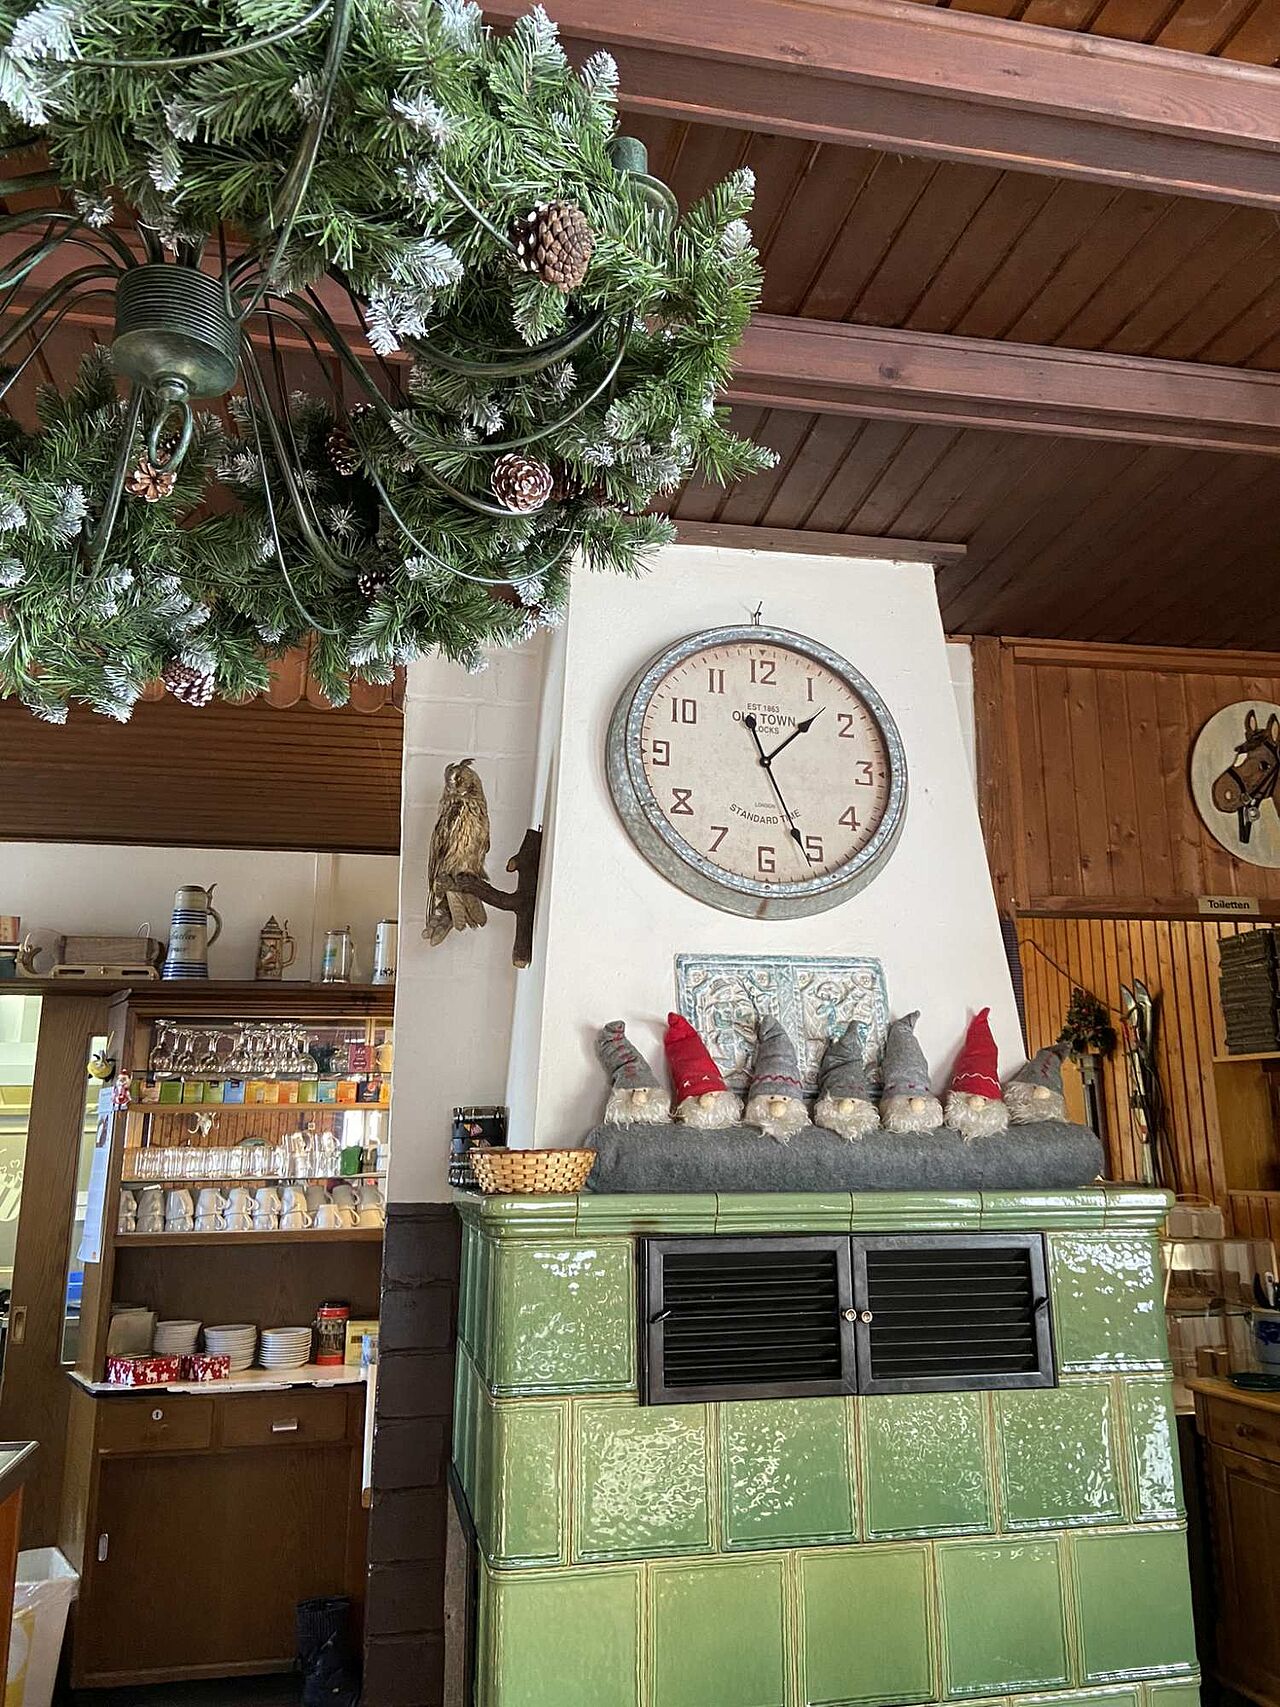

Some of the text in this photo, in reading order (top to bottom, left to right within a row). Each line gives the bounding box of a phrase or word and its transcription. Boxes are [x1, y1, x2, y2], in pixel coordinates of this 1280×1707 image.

[750, 659, 777, 686] 12
[671, 697, 697, 725] 10
[747, 703, 760, 711] EST
[760, 713, 796, 727] TOWN
[837, 713, 855, 739] 2
[652, 740, 670, 767] 9
[854, 761, 874, 786] 3
[670, 788, 694, 816] 8
[729, 803, 779, 825] STANDARD
[838, 806, 861, 832] 4
[708, 826, 729, 853] 7
[805, 835, 824, 862] 5
[1208, 899, 1250, 909] Toiletten
